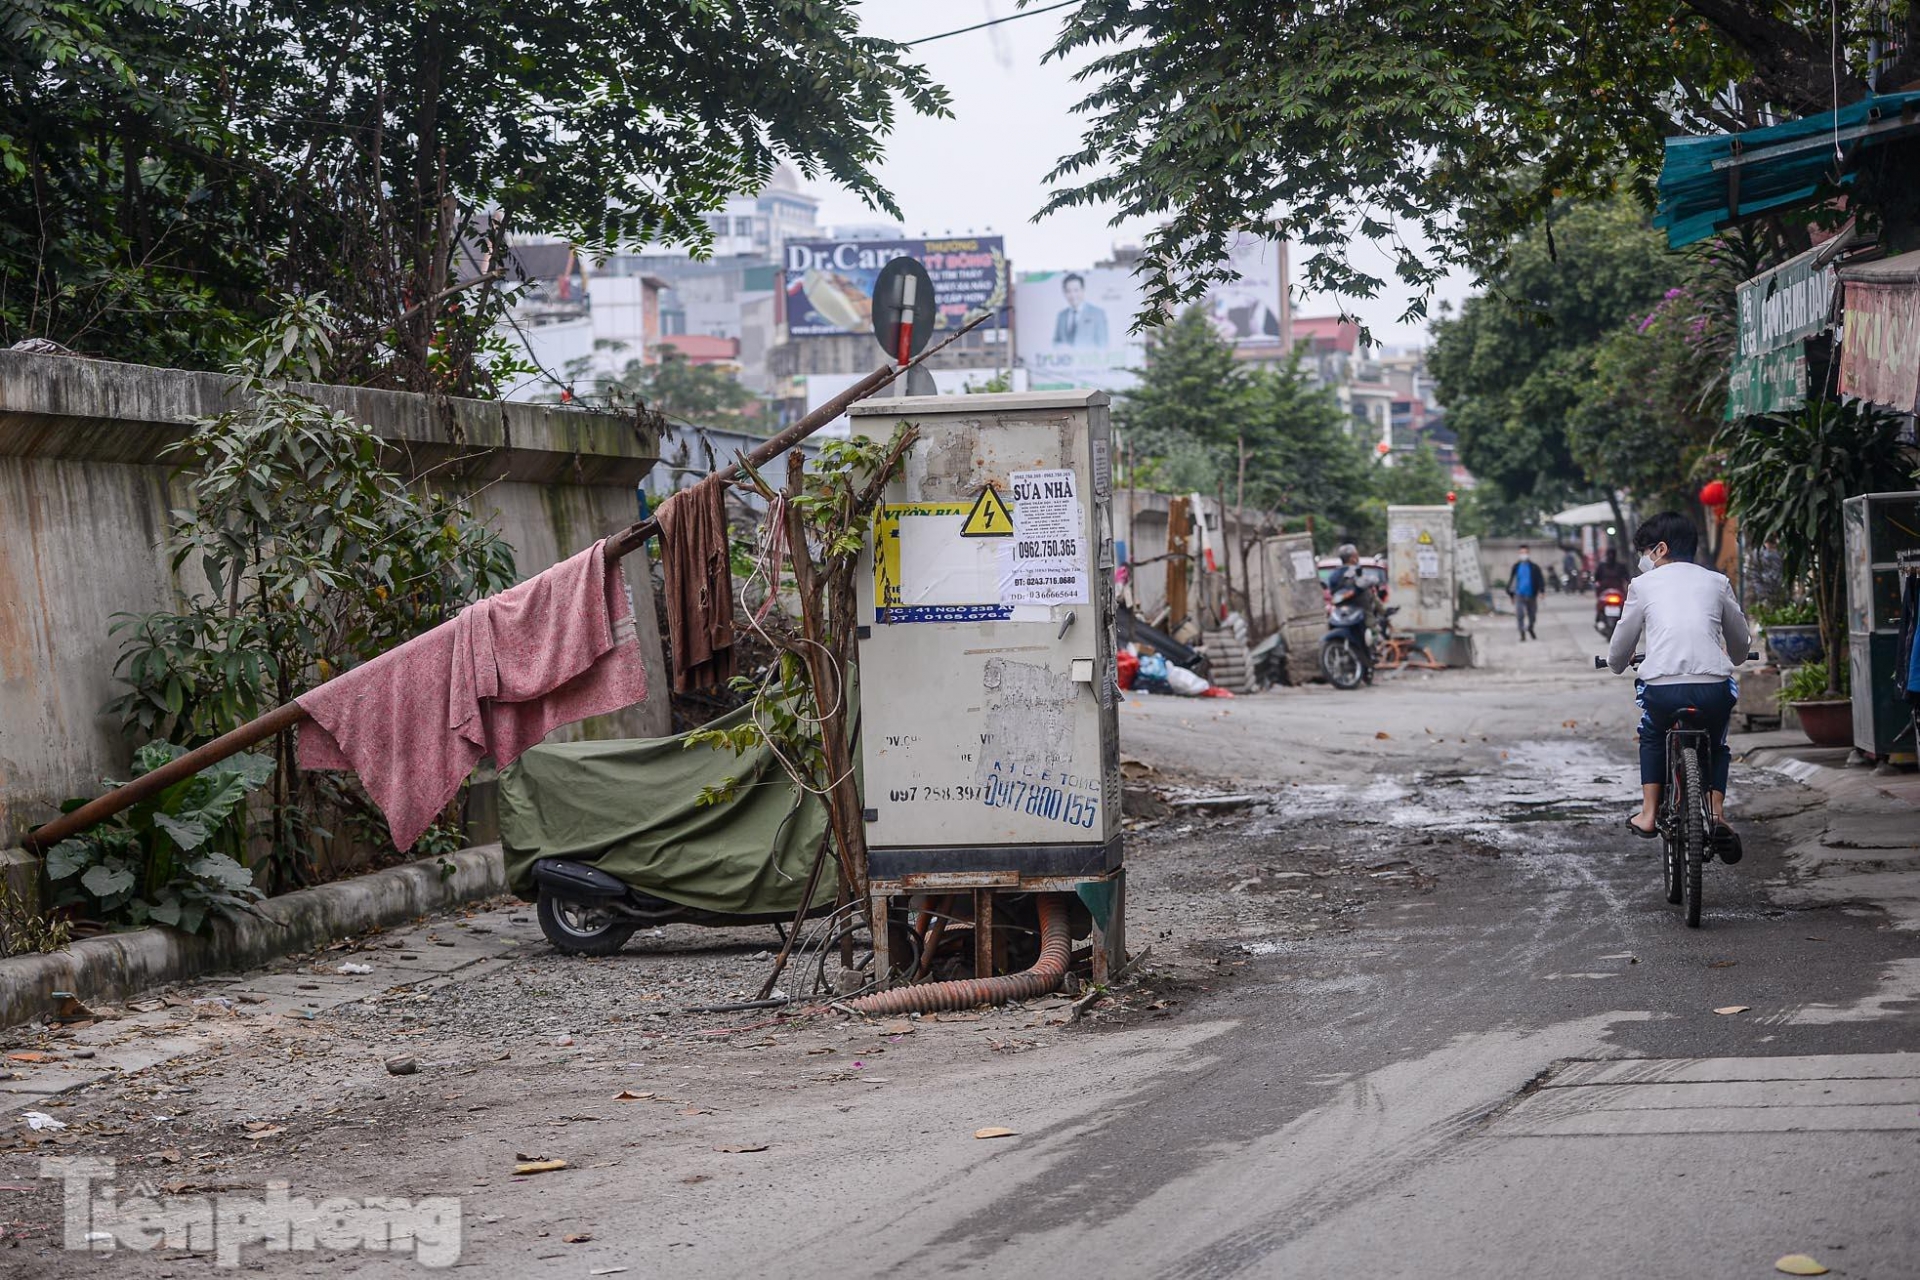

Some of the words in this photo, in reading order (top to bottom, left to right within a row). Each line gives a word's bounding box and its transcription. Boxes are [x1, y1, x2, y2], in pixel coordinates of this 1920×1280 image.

[1014, 479, 1041, 501] SỬA
[1044, 477, 1074, 499] NHÀ
[1018, 539, 1076, 559] 0962.750.365
